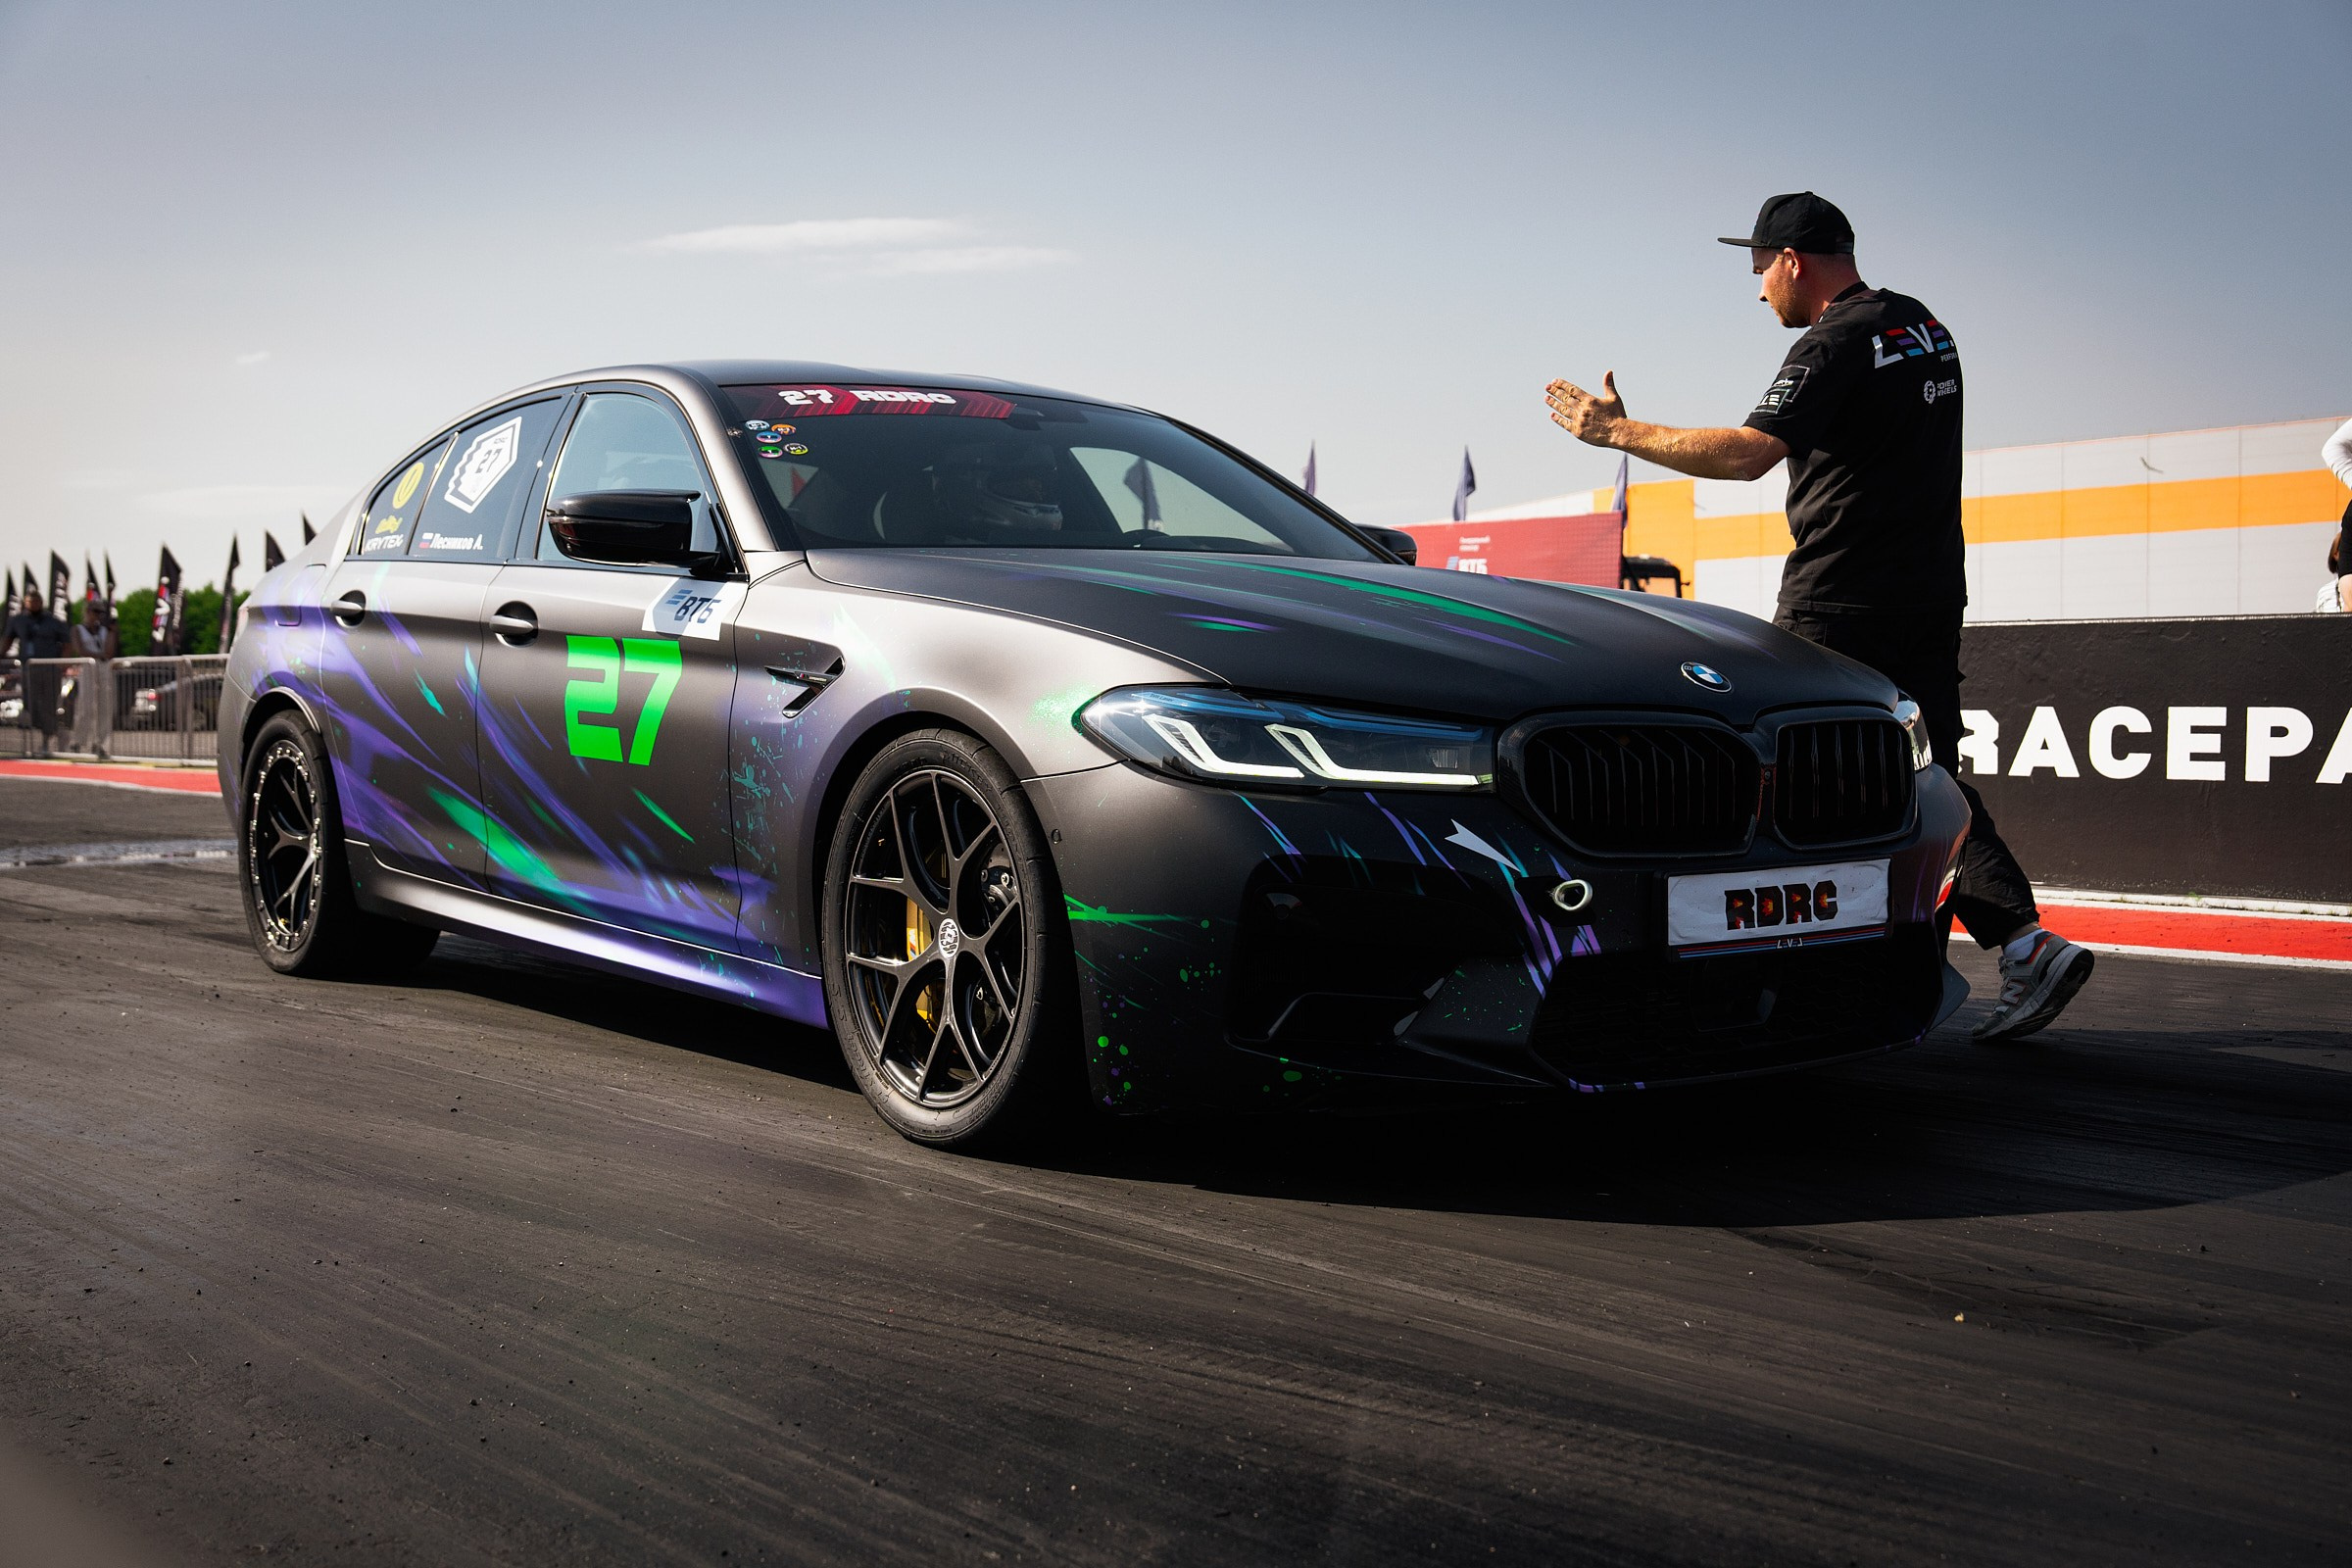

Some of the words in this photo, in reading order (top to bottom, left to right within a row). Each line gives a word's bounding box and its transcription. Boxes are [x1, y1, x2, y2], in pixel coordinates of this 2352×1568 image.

[778, 389, 834, 406] 27
[849, 389, 956, 404] RDRC
[475, 448, 503, 473] 27
[674, 596, 721, 624] ВТБ
[564, 634, 683, 766] 27
[1725, 880, 1838, 930] RDRC
